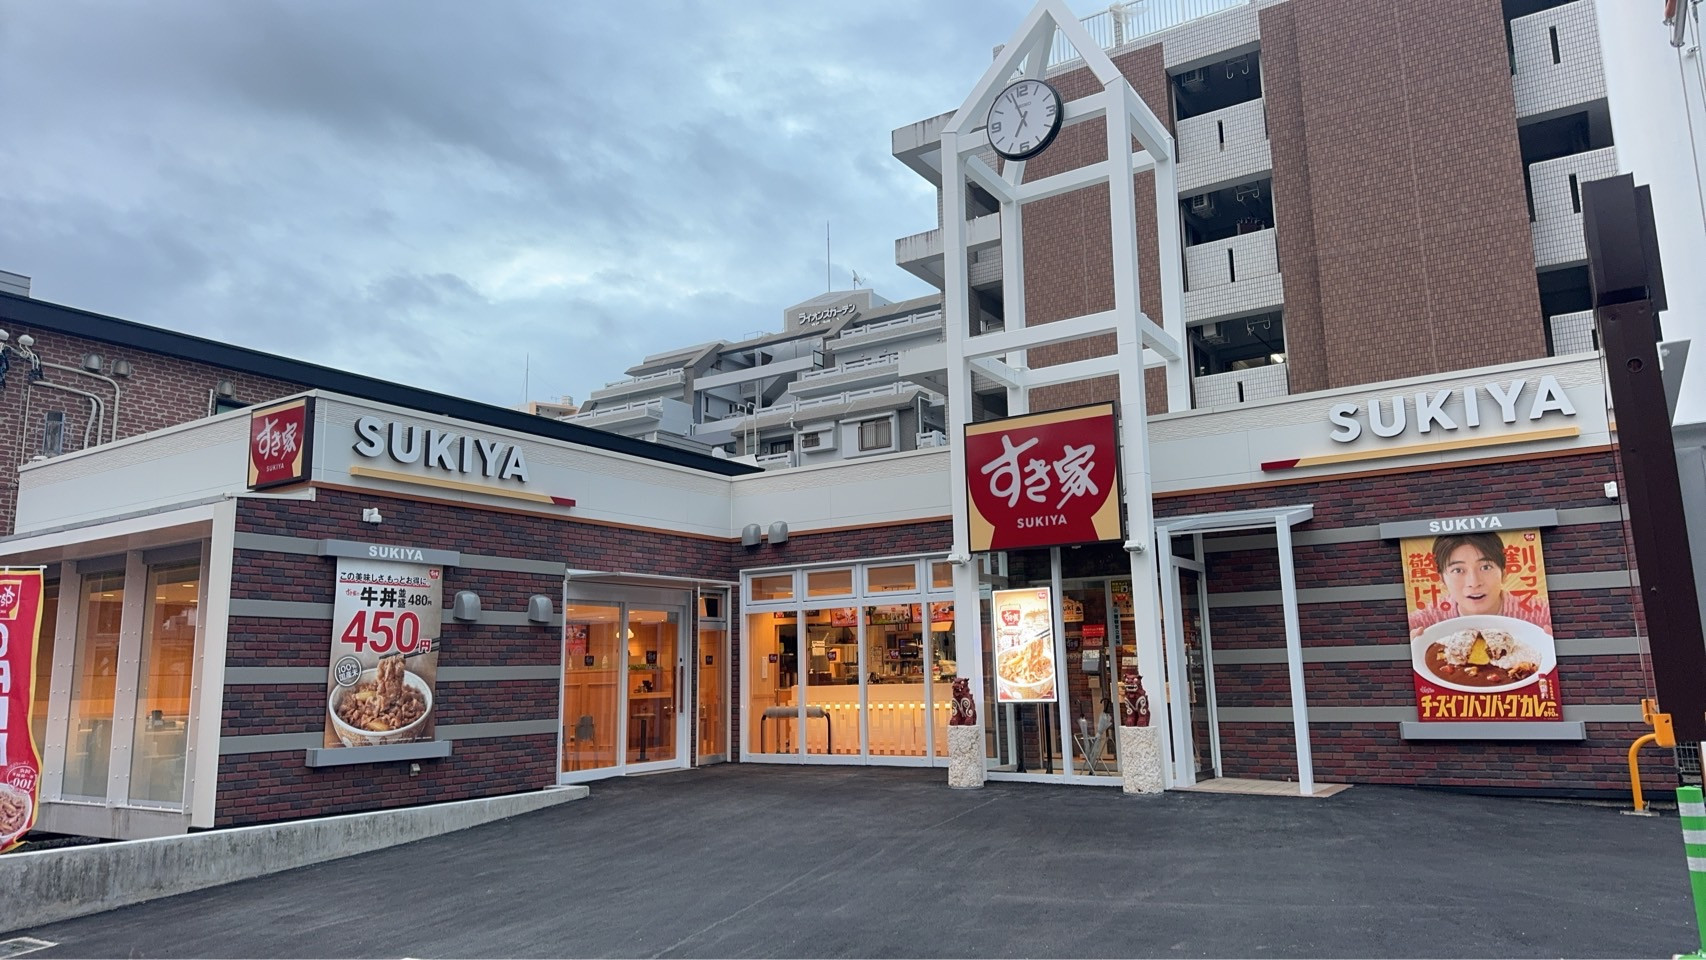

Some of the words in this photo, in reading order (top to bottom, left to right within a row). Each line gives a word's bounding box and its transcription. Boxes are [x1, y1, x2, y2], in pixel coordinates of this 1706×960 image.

[1016, 85, 1028, 98] 12
[1046, 105, 1055, 117] 3
[991, 121, 1002, 134] 9
[1020, 141, 1030, 152] 6
[1328, 374, 1577, 443] SUKIYA
[256, 416, 298, 461] すき家
[351, 415, 530, 483] SUKIYA
[266, 462, 285, 473] SUKIYA
[980, 434, 1099, 510] すき家
[1016, 514, 1068, 529] SUKIYA
[1429, 515, 1503, 533] SUKIYA
[368, 545, 424, 561] SUKIYA
[1409, 552, 1451, 612] 驚け。
[1503, 545, 1542, 613] 割って、
[360, 587, 397, 608] 牛丼
[340, 610, 432, 654] 450円
[1421, 694, 1557, 718] チーズインハンバーグカレー
